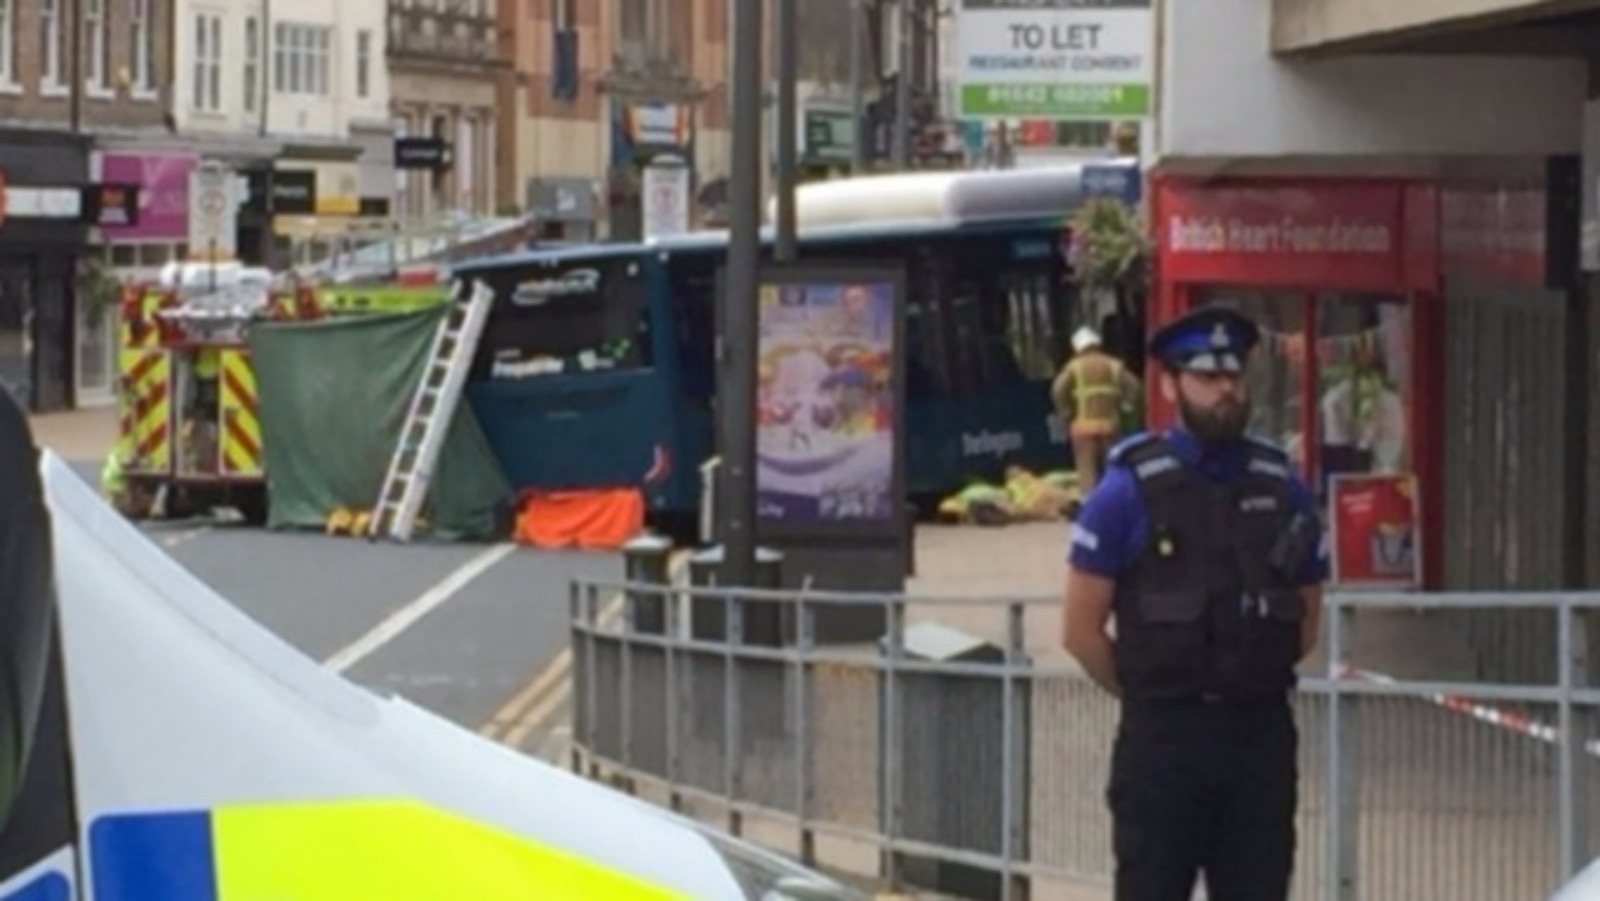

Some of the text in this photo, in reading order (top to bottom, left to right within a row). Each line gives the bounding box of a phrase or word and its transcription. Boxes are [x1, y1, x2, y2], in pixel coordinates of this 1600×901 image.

[1009, 24, 1102, 50] TO LET
[969, 56, 1066, 70] RESTAURANT
[1168, 215, 1225, 252] British
[1229, 216, 1280, 252] Heart
[1282, 215, 1390, 252] Foundation
